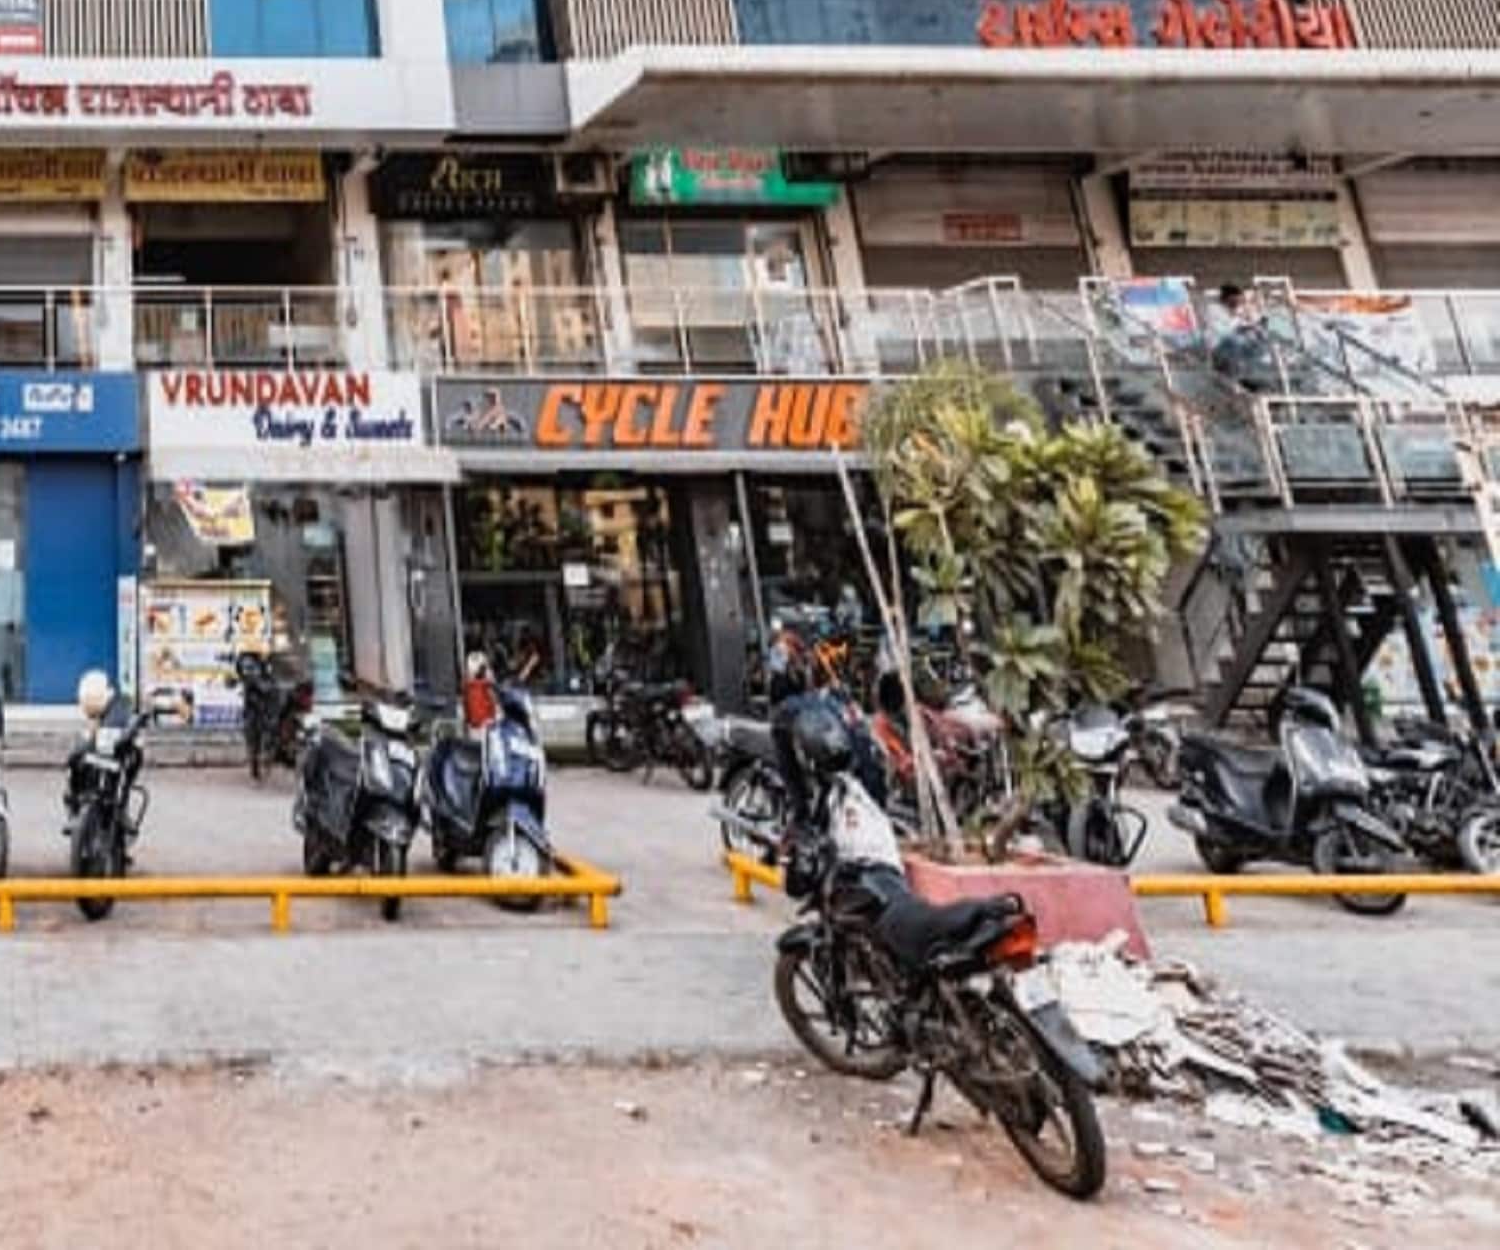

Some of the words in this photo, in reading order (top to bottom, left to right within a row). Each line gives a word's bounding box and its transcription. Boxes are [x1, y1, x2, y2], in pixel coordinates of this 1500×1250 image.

[160, 373, 372, 407] VRUNDAVAN
[254, 407, 314, 447] Dairy
[320, 407, 337, 440] &
[346, 409, 414, 440] Sweets
[534, 382, 726, 448] CYCLE
[747, 382, 870, 448] HUB
